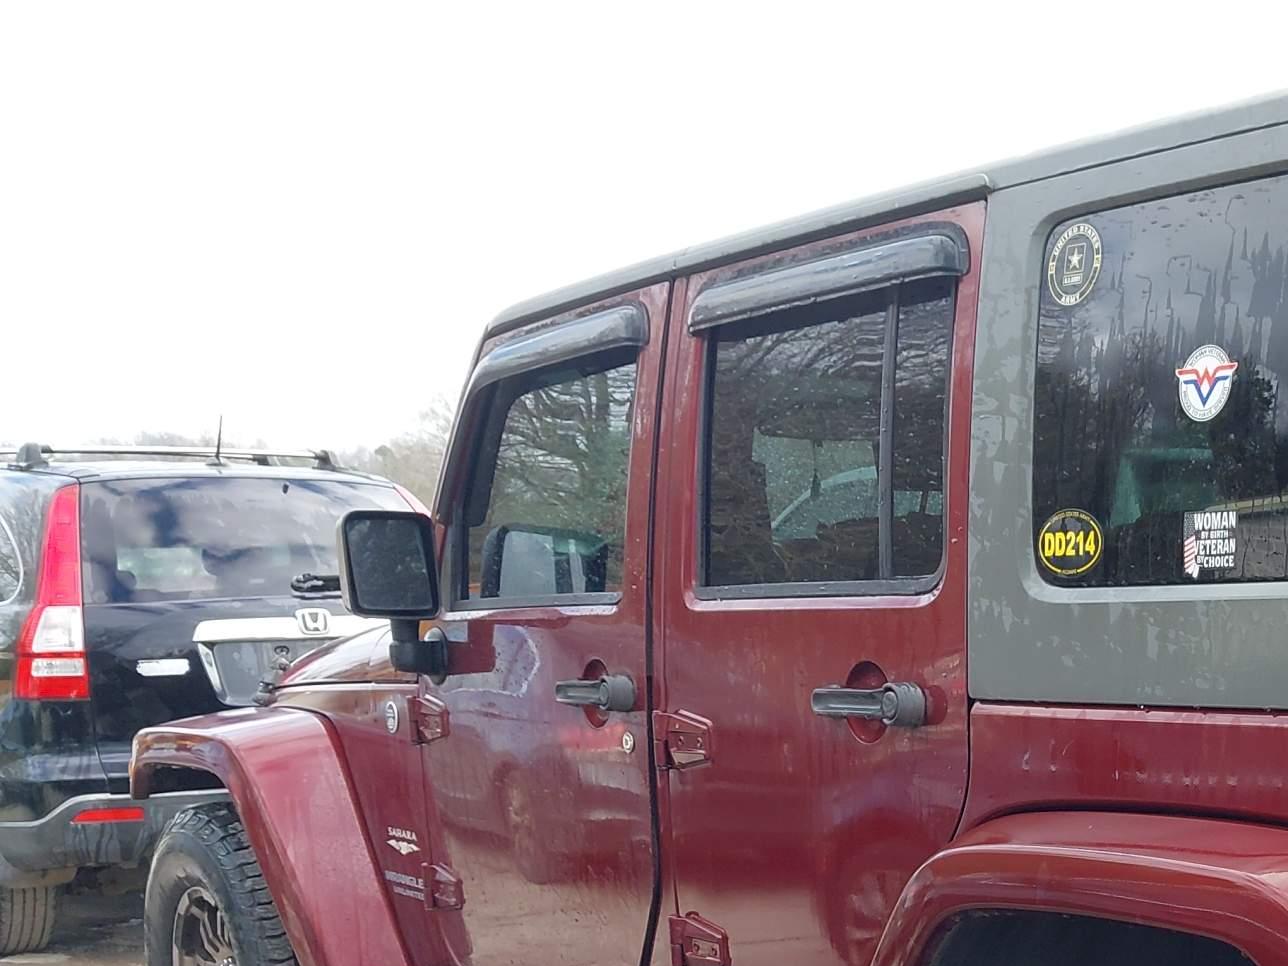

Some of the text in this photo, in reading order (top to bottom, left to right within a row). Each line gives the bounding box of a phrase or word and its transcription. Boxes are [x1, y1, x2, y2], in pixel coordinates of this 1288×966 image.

[1194, 511, 1236, 530] WOMAN
[1044, 530, 1095, 557] DD214
[1195, 538, 1236, 555] VETERAN
[1204, 555, 1234, 568] CHOICE
[387, 827, 418, 841] SAHARA
